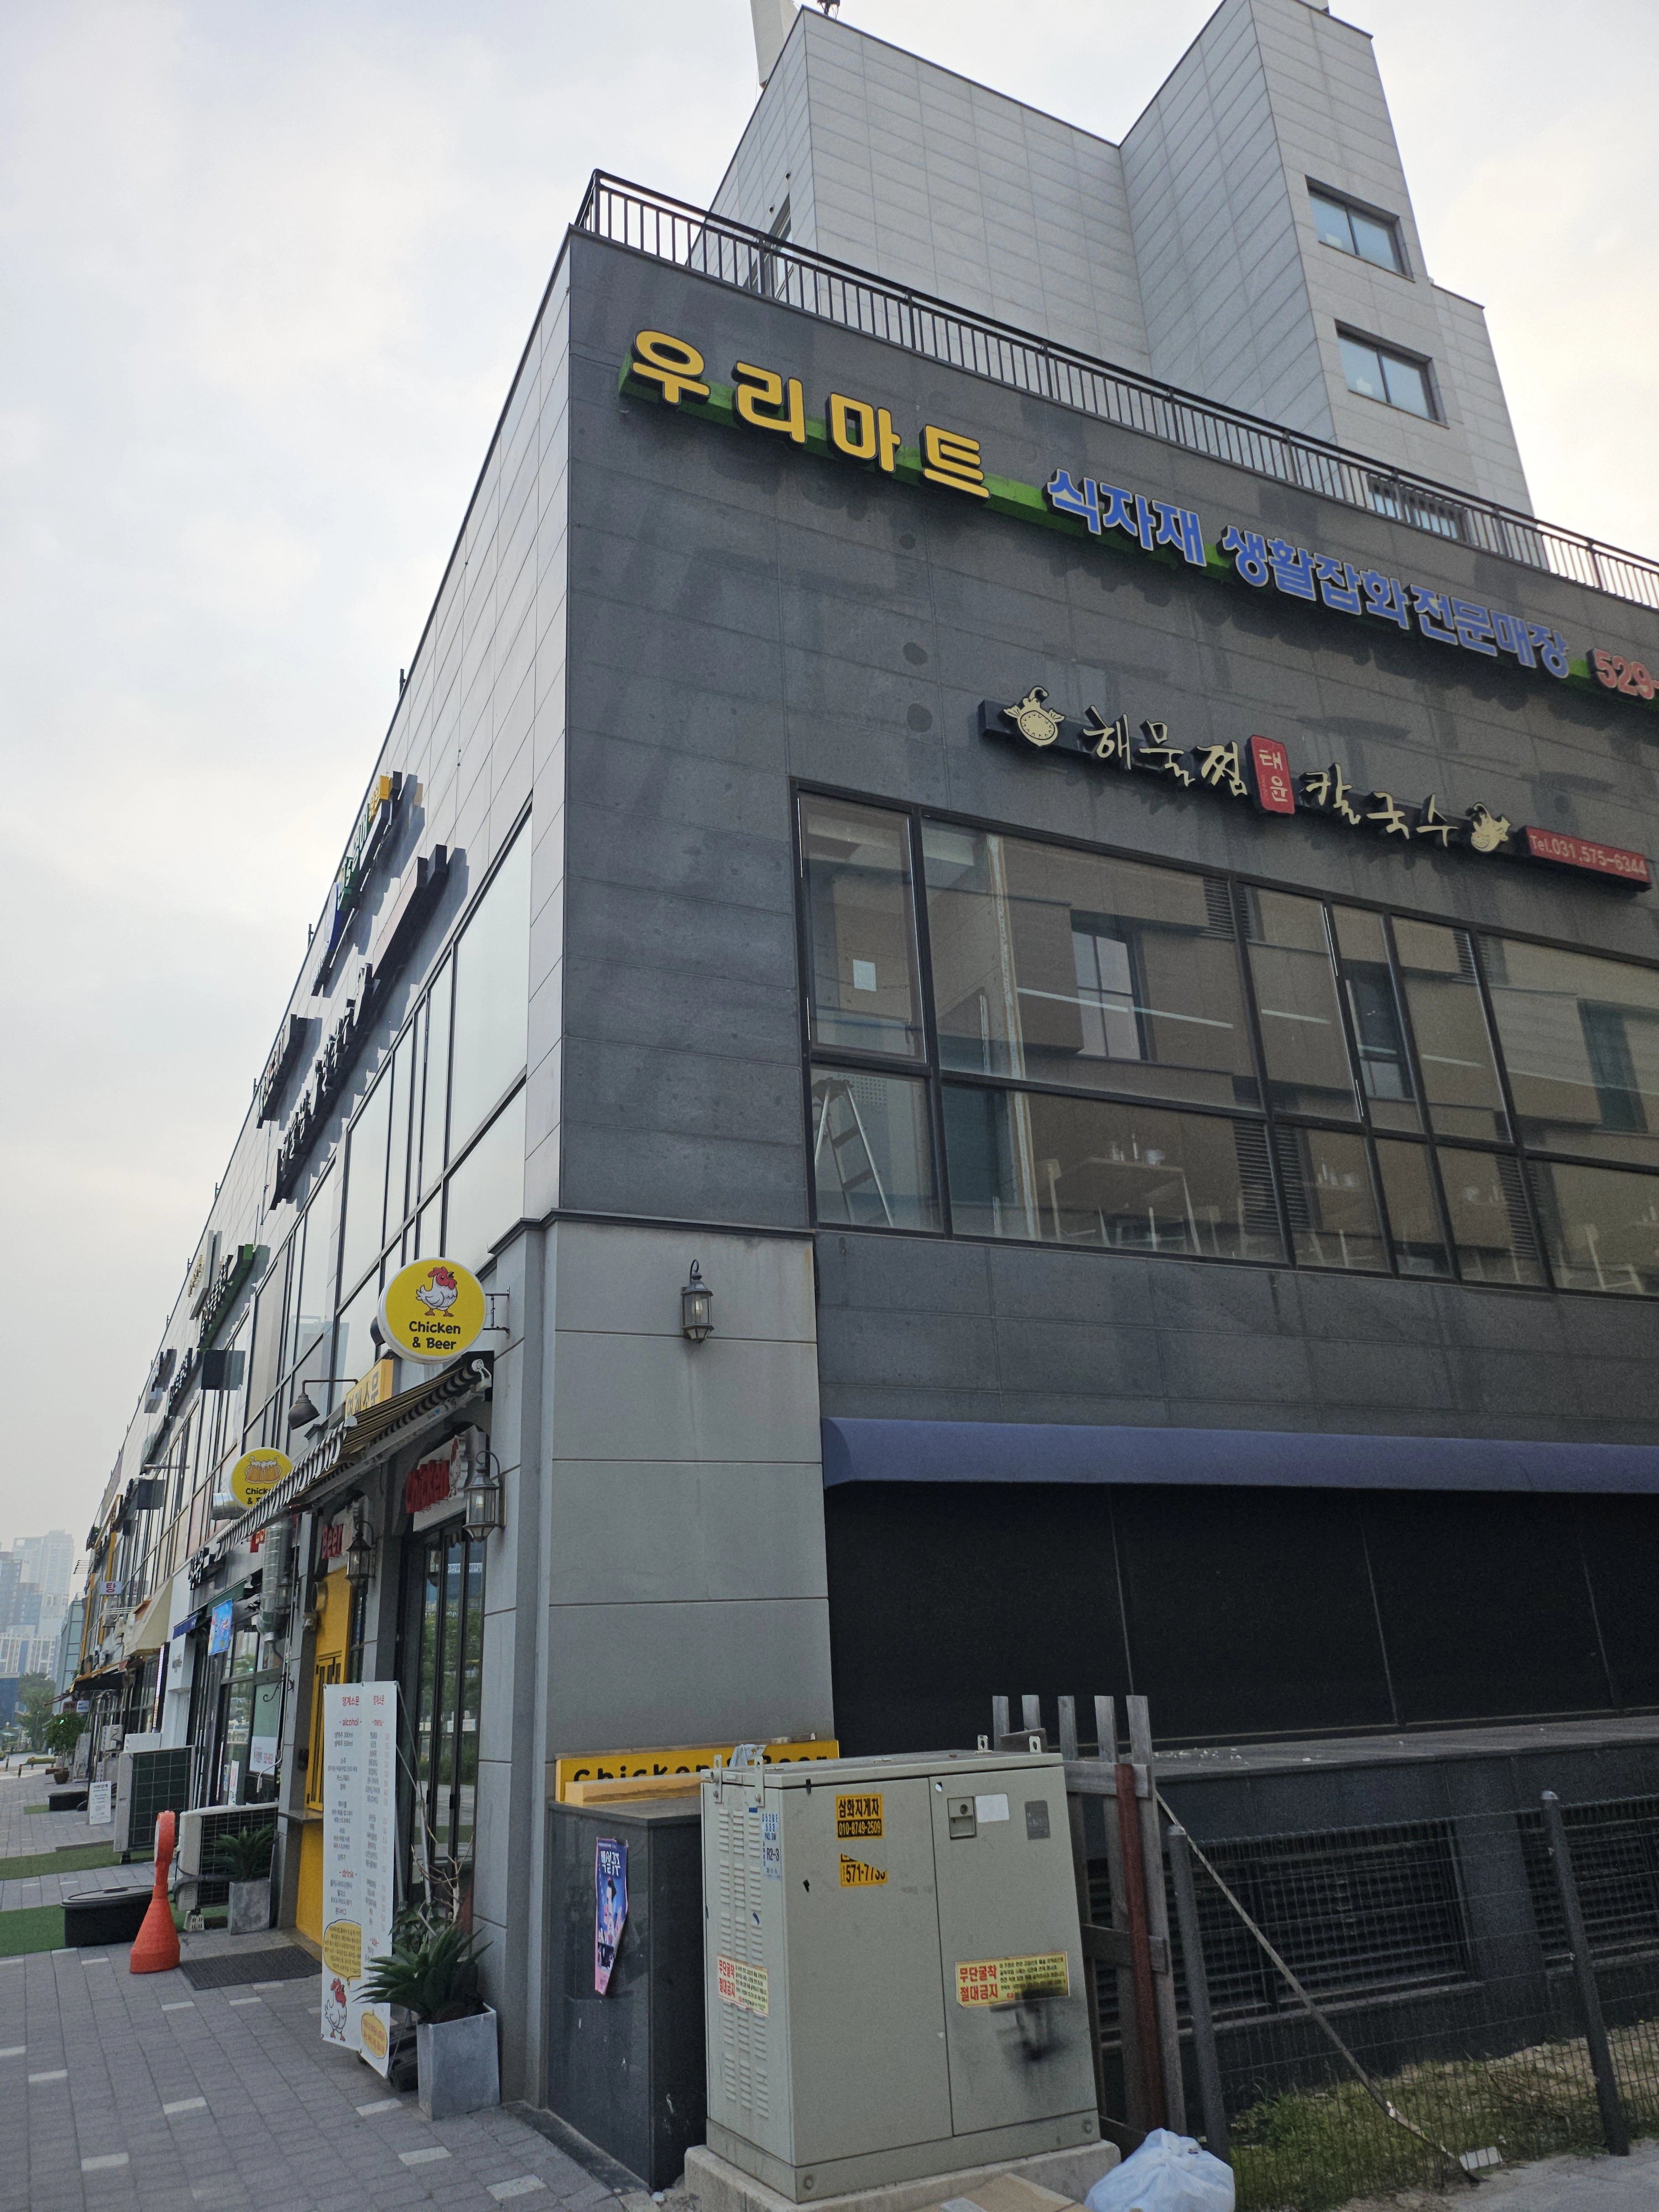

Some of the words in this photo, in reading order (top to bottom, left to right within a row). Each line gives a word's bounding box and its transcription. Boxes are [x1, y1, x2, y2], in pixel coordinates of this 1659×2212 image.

[630, 329, 991, 499] 우리마트
[1047, 468, 1207, 567] 식자재
[1082, 704, 1248, 796] 해물찜
[1304, 763, 1459, 848] 칼국수
[409, 1321, 461, 1334] Chicken
[412, 1337, 421, 1348] &
[426, 1337, 457, 1350] Beer
[106, 1582, 117, 1593] 탕
[959, 1964, 997, 1983] 무단굴착
[960, 1983, 998, 2002] 절대금지
